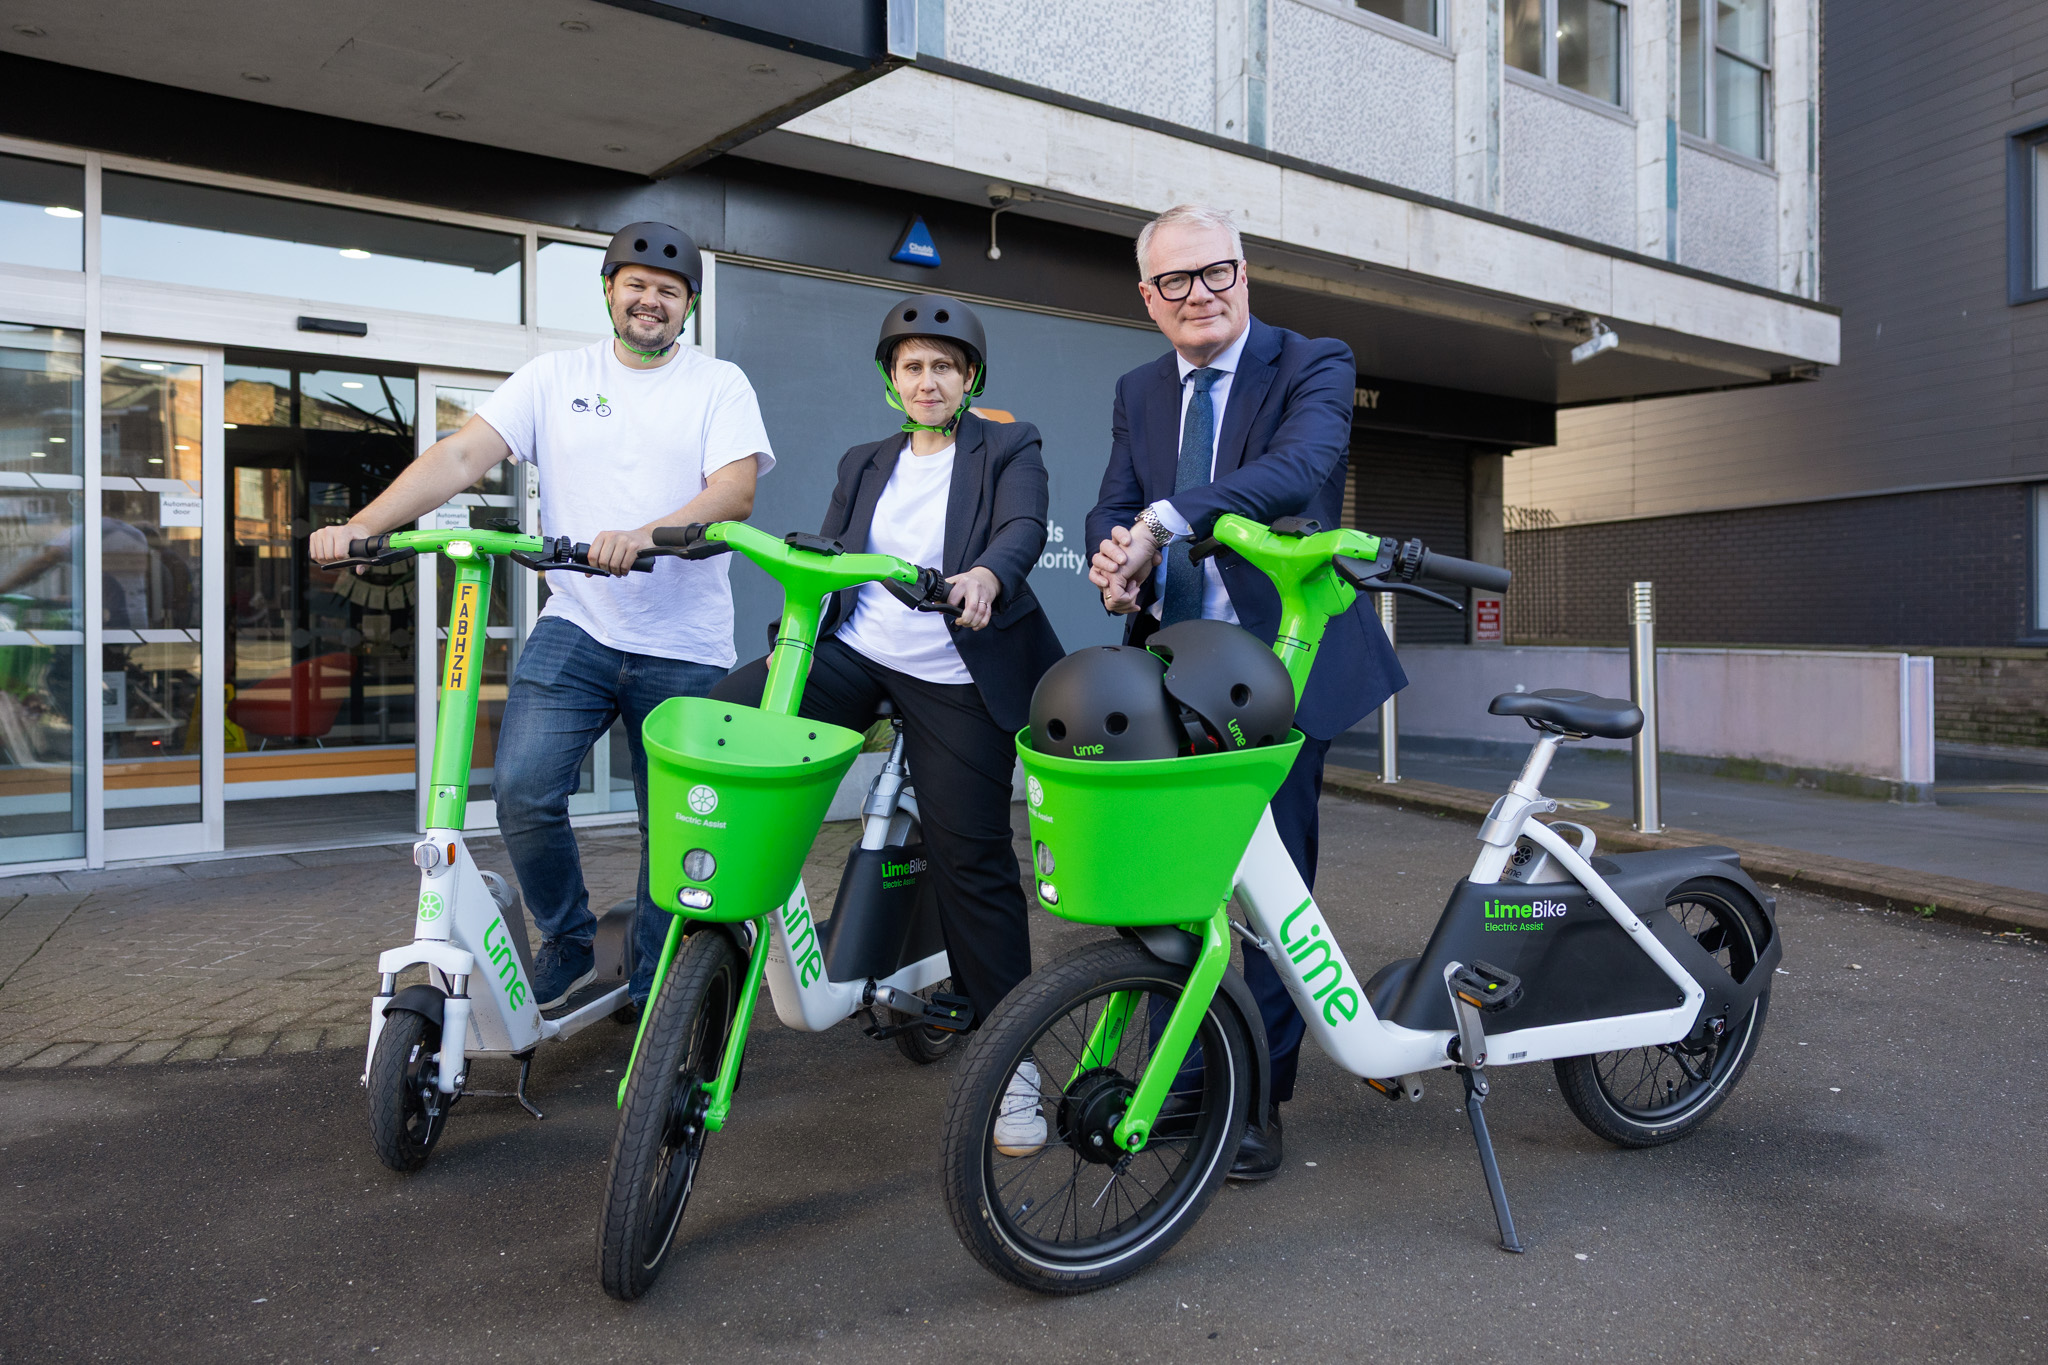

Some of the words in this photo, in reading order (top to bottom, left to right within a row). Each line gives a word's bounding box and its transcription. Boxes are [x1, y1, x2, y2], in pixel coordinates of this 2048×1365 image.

[450, 585, 473, 688] FABHZH
[1227, 718, 1247, 748] Lime
[1073, 743, 1104, 757] Lime
[675, 812, 702, 826] Electric
[702, 819, 727, 829] Assist
[881, 858, 928, 878] LimeBike
[883, 879, 903, 889] Electric
[1484, 899, 1567, 919] LimeBike
[1484, 922, 1518, 932] Electric
[1519, 922, 1544, 931] Assist
[483, 916, 526, 1012] Lime
[1279, 896, 1359, 1028] Lime
